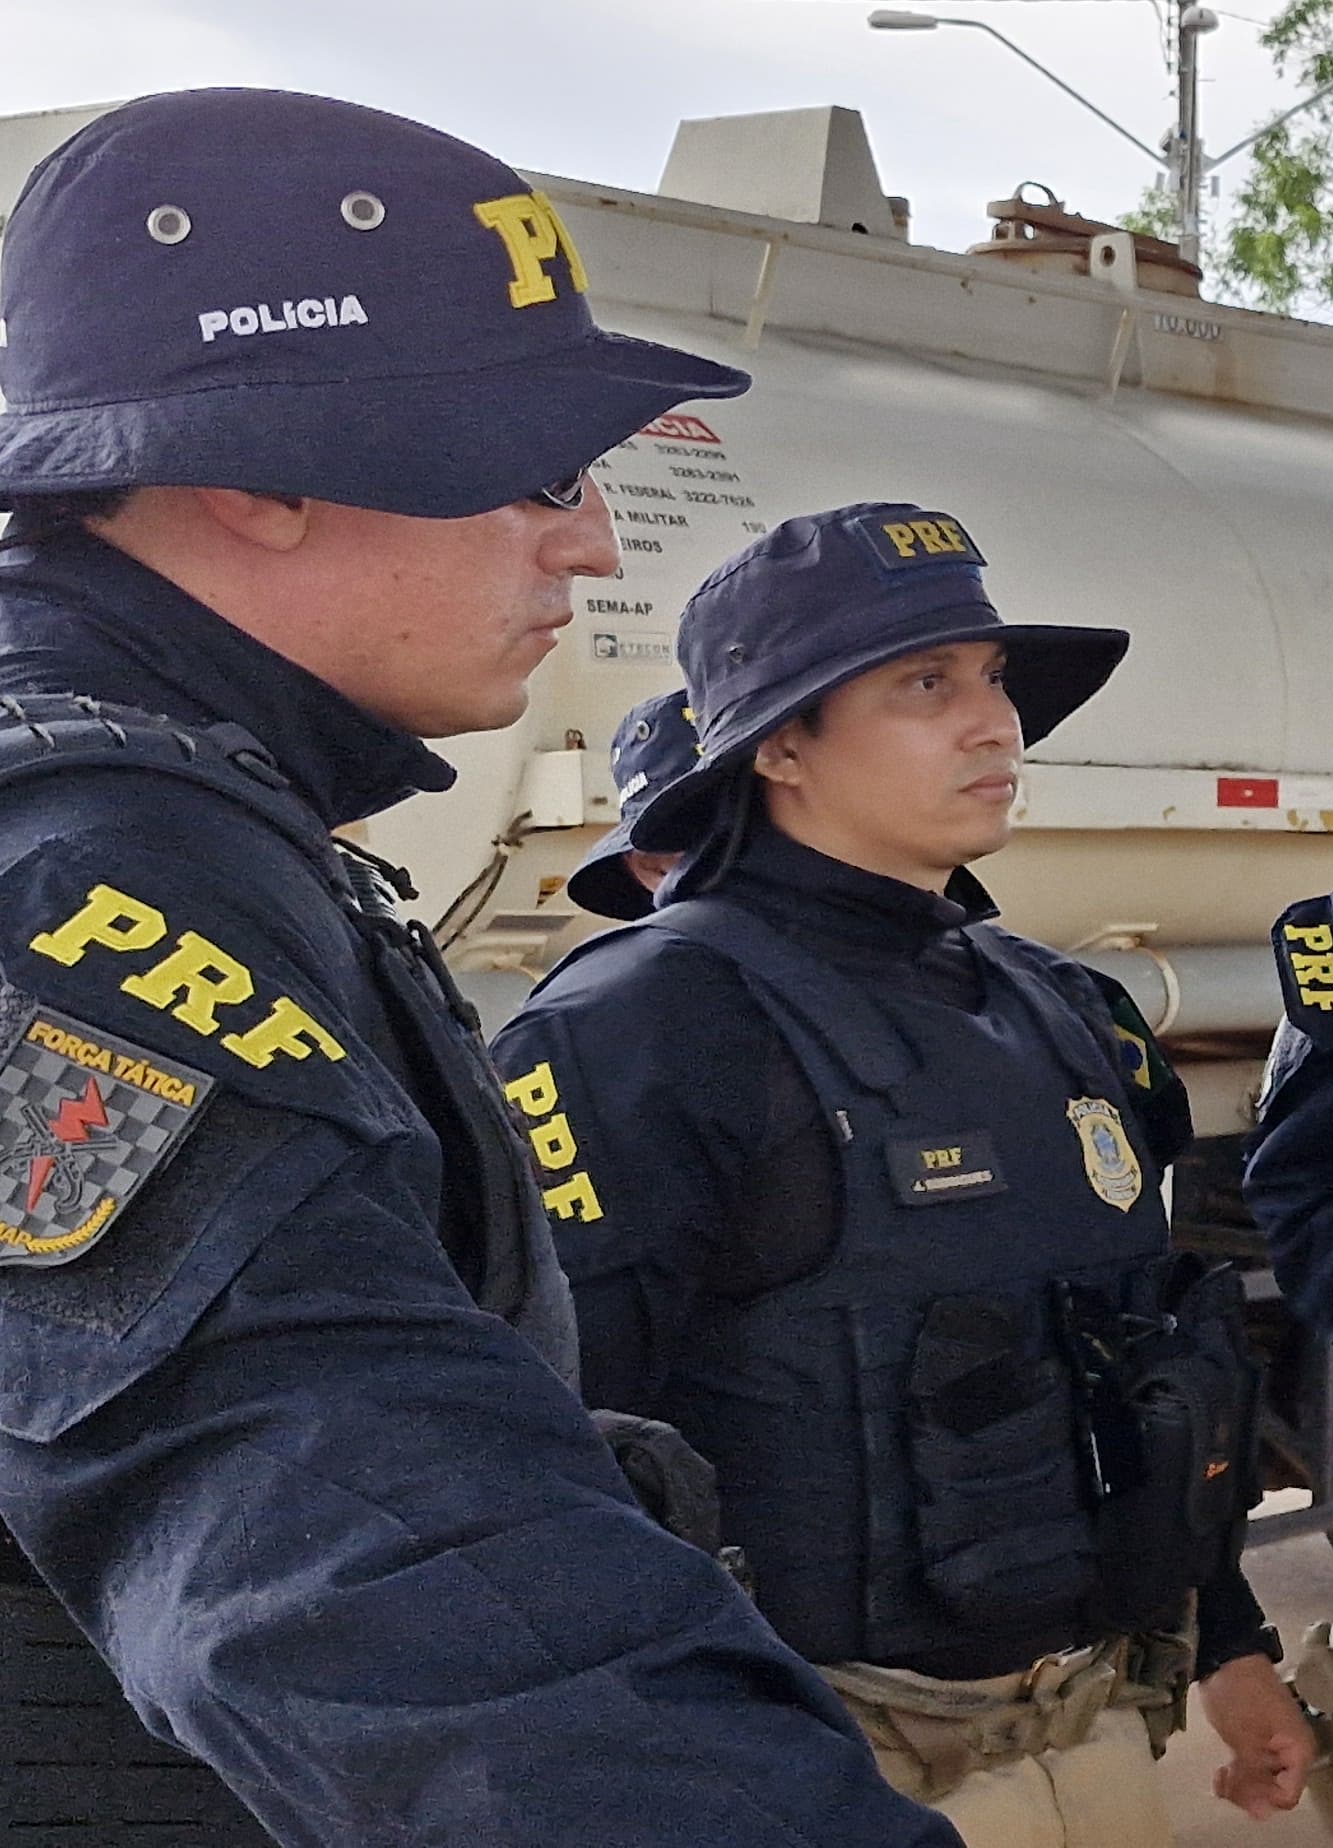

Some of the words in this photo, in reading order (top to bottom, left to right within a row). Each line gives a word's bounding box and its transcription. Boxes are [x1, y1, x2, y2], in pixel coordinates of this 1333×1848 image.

[620, 484, 677, 501] FEDERAL
[625, 511, 690, 527] MILITAR
[882, 518, 969, 558] PRF
[586, 599, 653, 616] SEMA-AP
[29, 883, 347, 1070] PRF
[27, 1020, 112, 1074] FORÇA
[113, 1057, 195, 1106] TÁTICA
[921, 1147, 962, 1169] PRF
